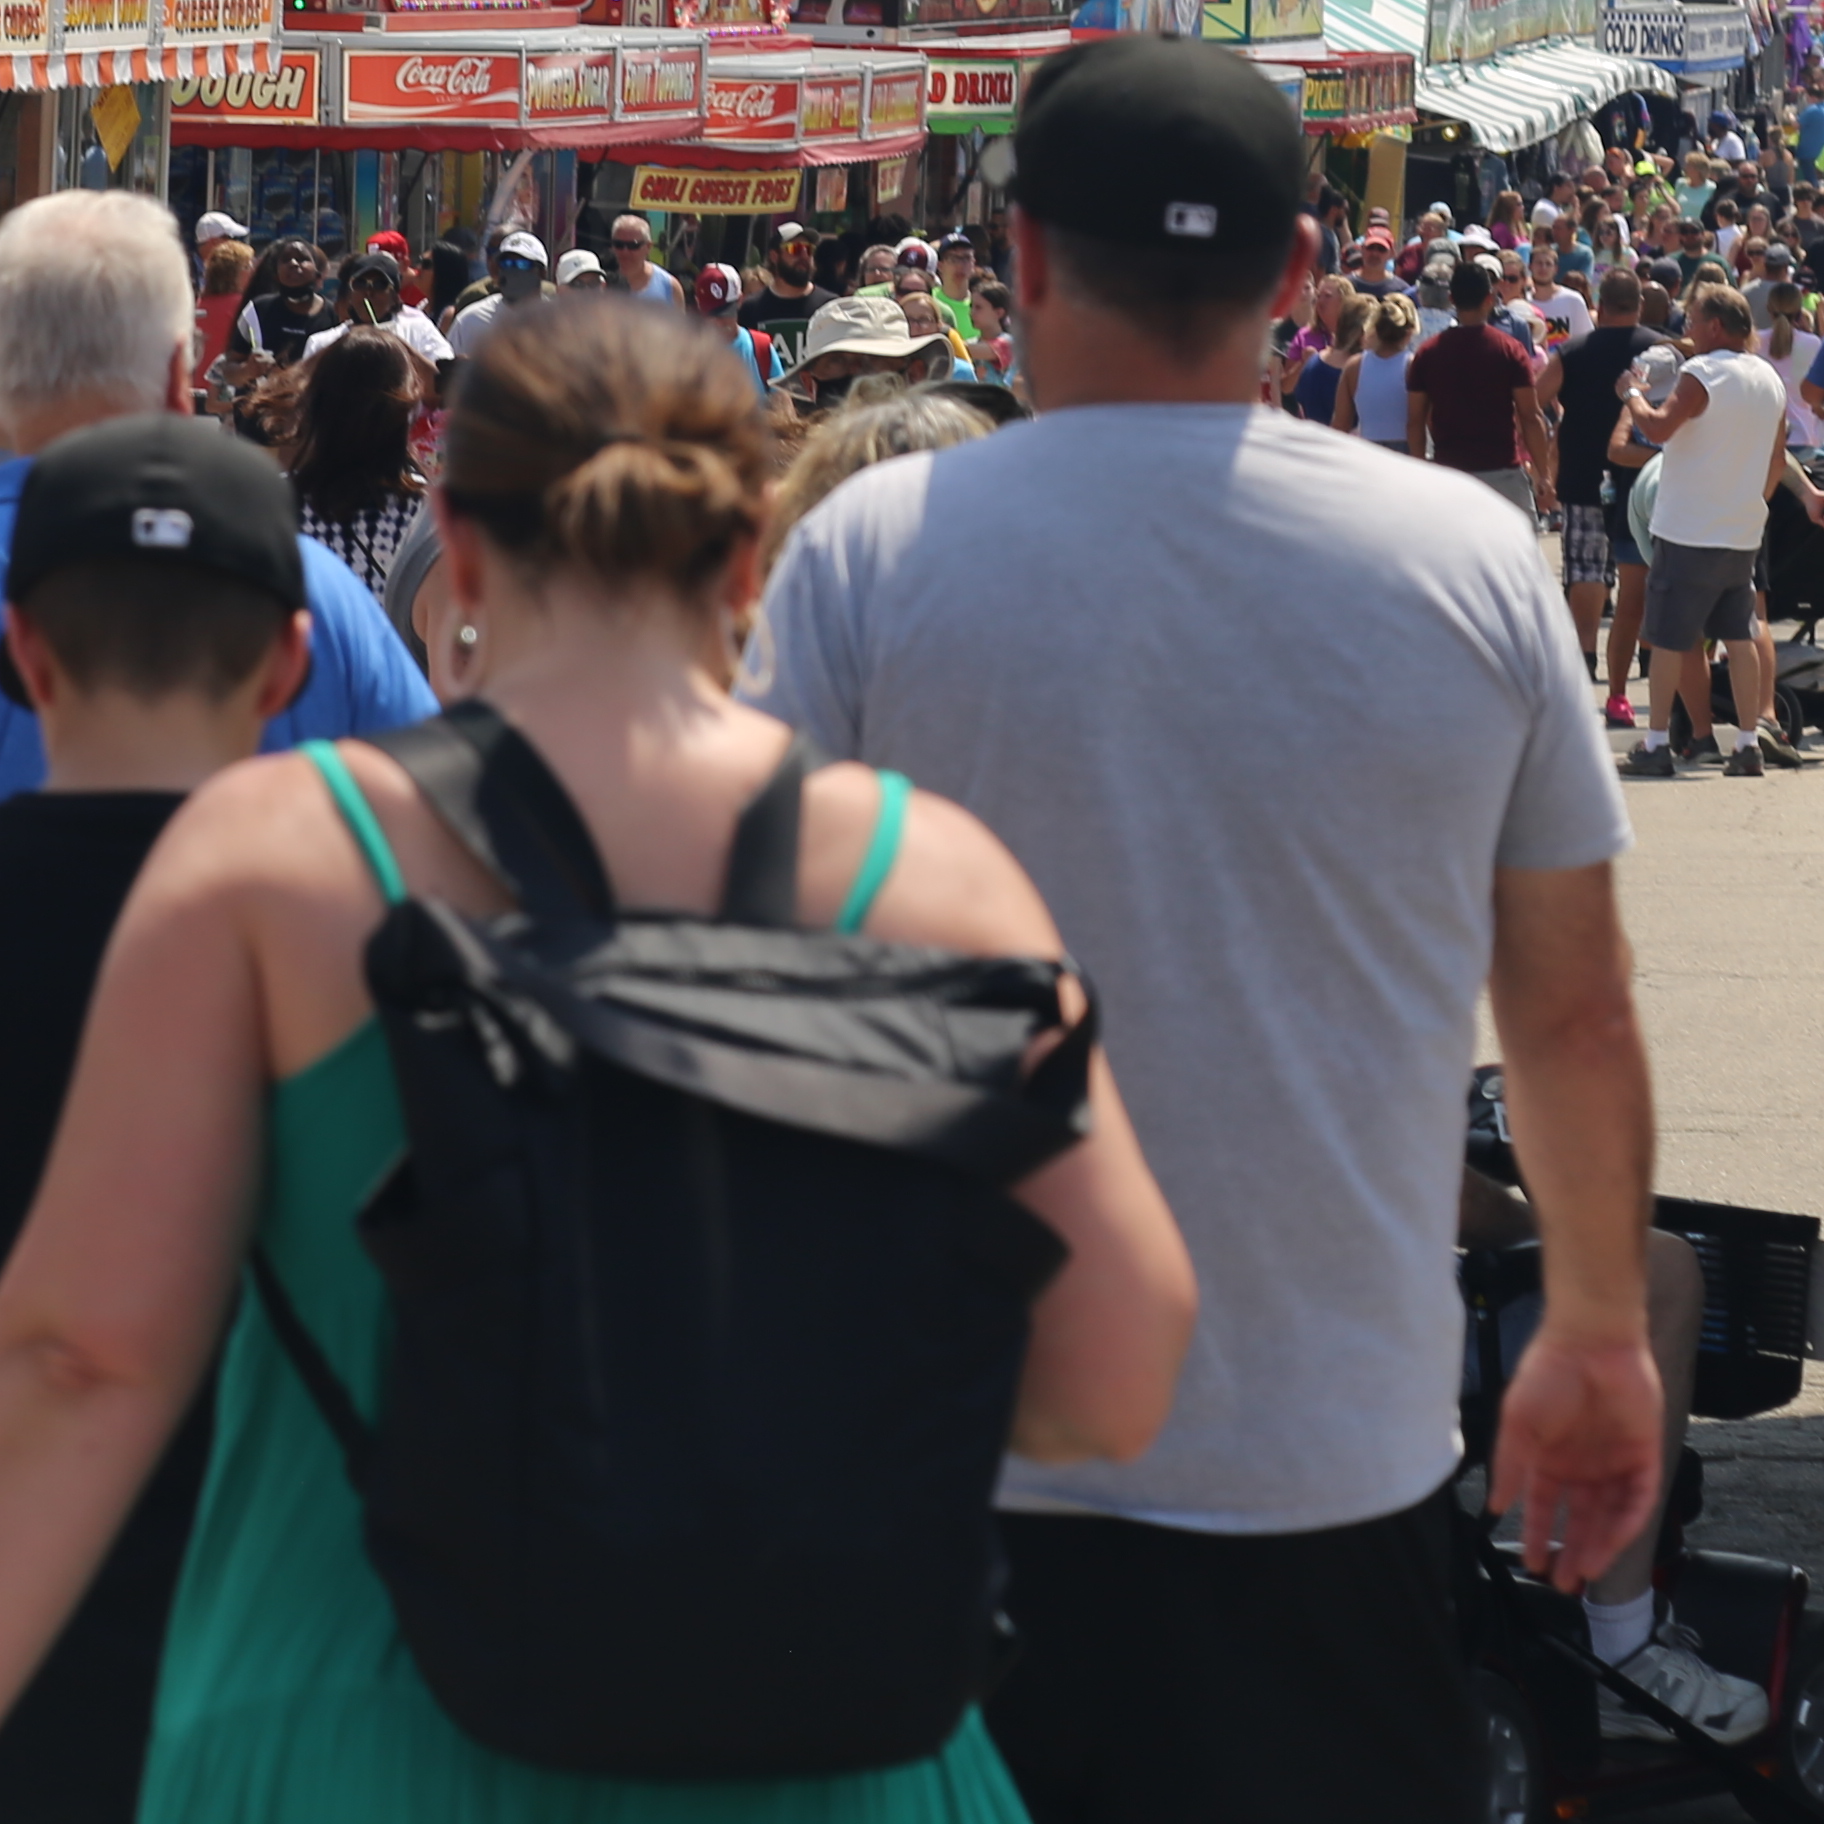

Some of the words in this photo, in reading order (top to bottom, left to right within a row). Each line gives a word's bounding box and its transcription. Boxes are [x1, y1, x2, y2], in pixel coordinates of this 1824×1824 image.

[3, 3, 41, 41] CURDS
[1604, 23, 1637, 53] COLD
[1639, 22, 1685, 57] DRINKS
[395, 56, 493, 95] Coca-Cola
[707, 83, 777, 118] oca-Cola
